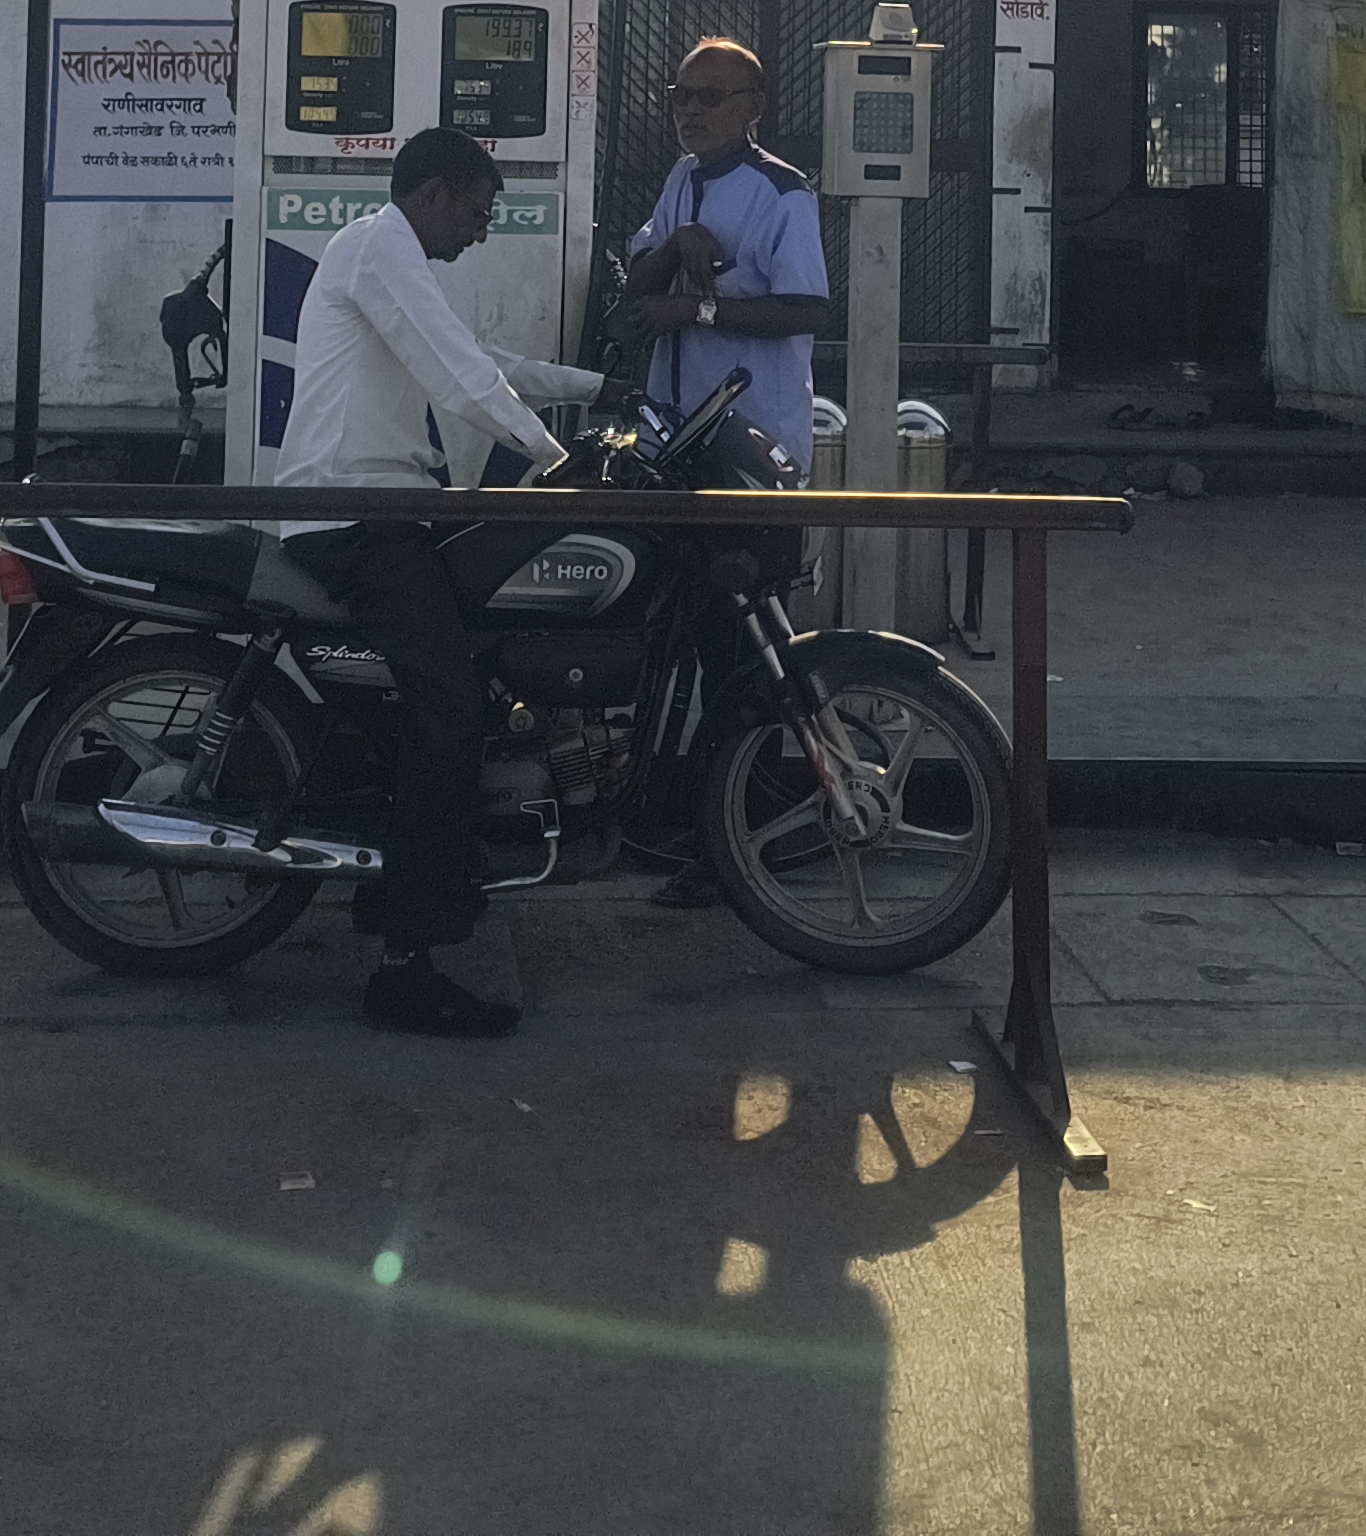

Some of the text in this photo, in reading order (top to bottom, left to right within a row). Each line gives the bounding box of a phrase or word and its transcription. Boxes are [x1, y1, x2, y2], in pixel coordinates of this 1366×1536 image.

[136, 40, 195, 84] सैनिक
[101, 92, 206, 116] राणीसावरगाव
[334, 137, 396, 154] कृपया
[81, 151, 120, 167] पंपाची
[140, 151, 178, 168] सकाळी
[200, 152, 225, 167] रात्री
[279, 193, 383, 225] Petr
[557, 564, 608, 580] Hero
